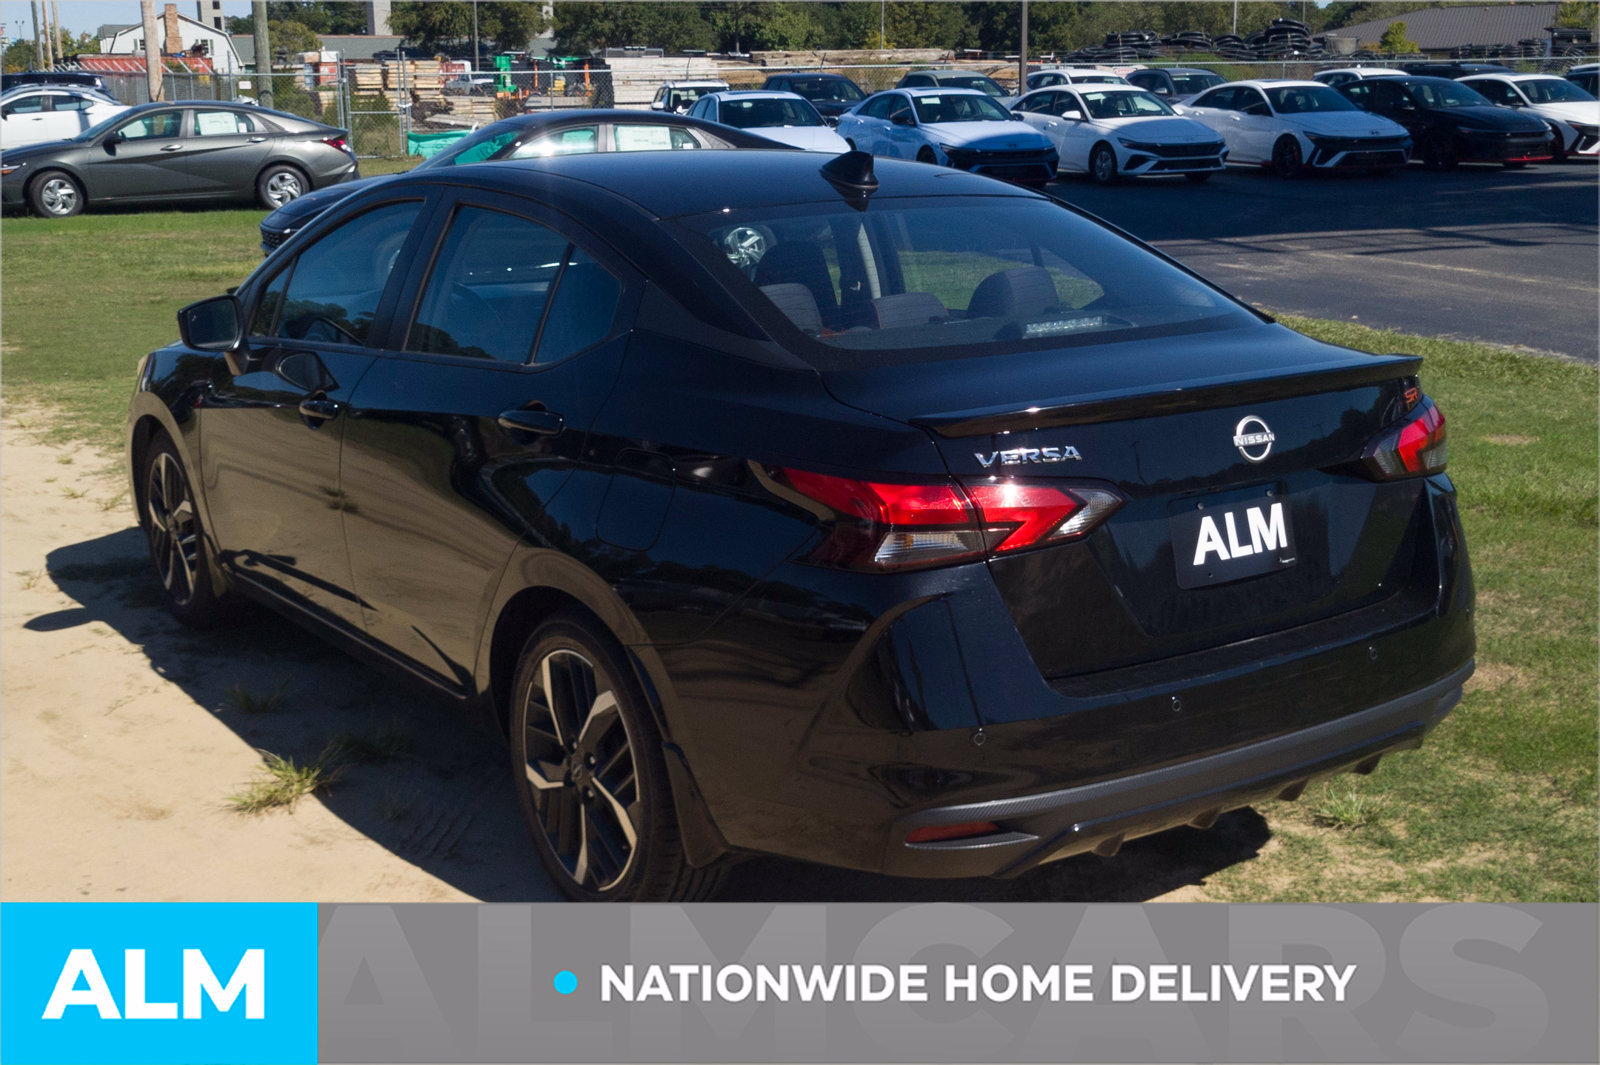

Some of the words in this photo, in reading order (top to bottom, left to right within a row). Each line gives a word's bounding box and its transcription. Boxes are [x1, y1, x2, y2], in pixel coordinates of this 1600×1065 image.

[1233, 433, 1275, 447] NISSAN
[974, 446, 1082, 468] VERSA
[1193, 502, 1288, 566] ALM
